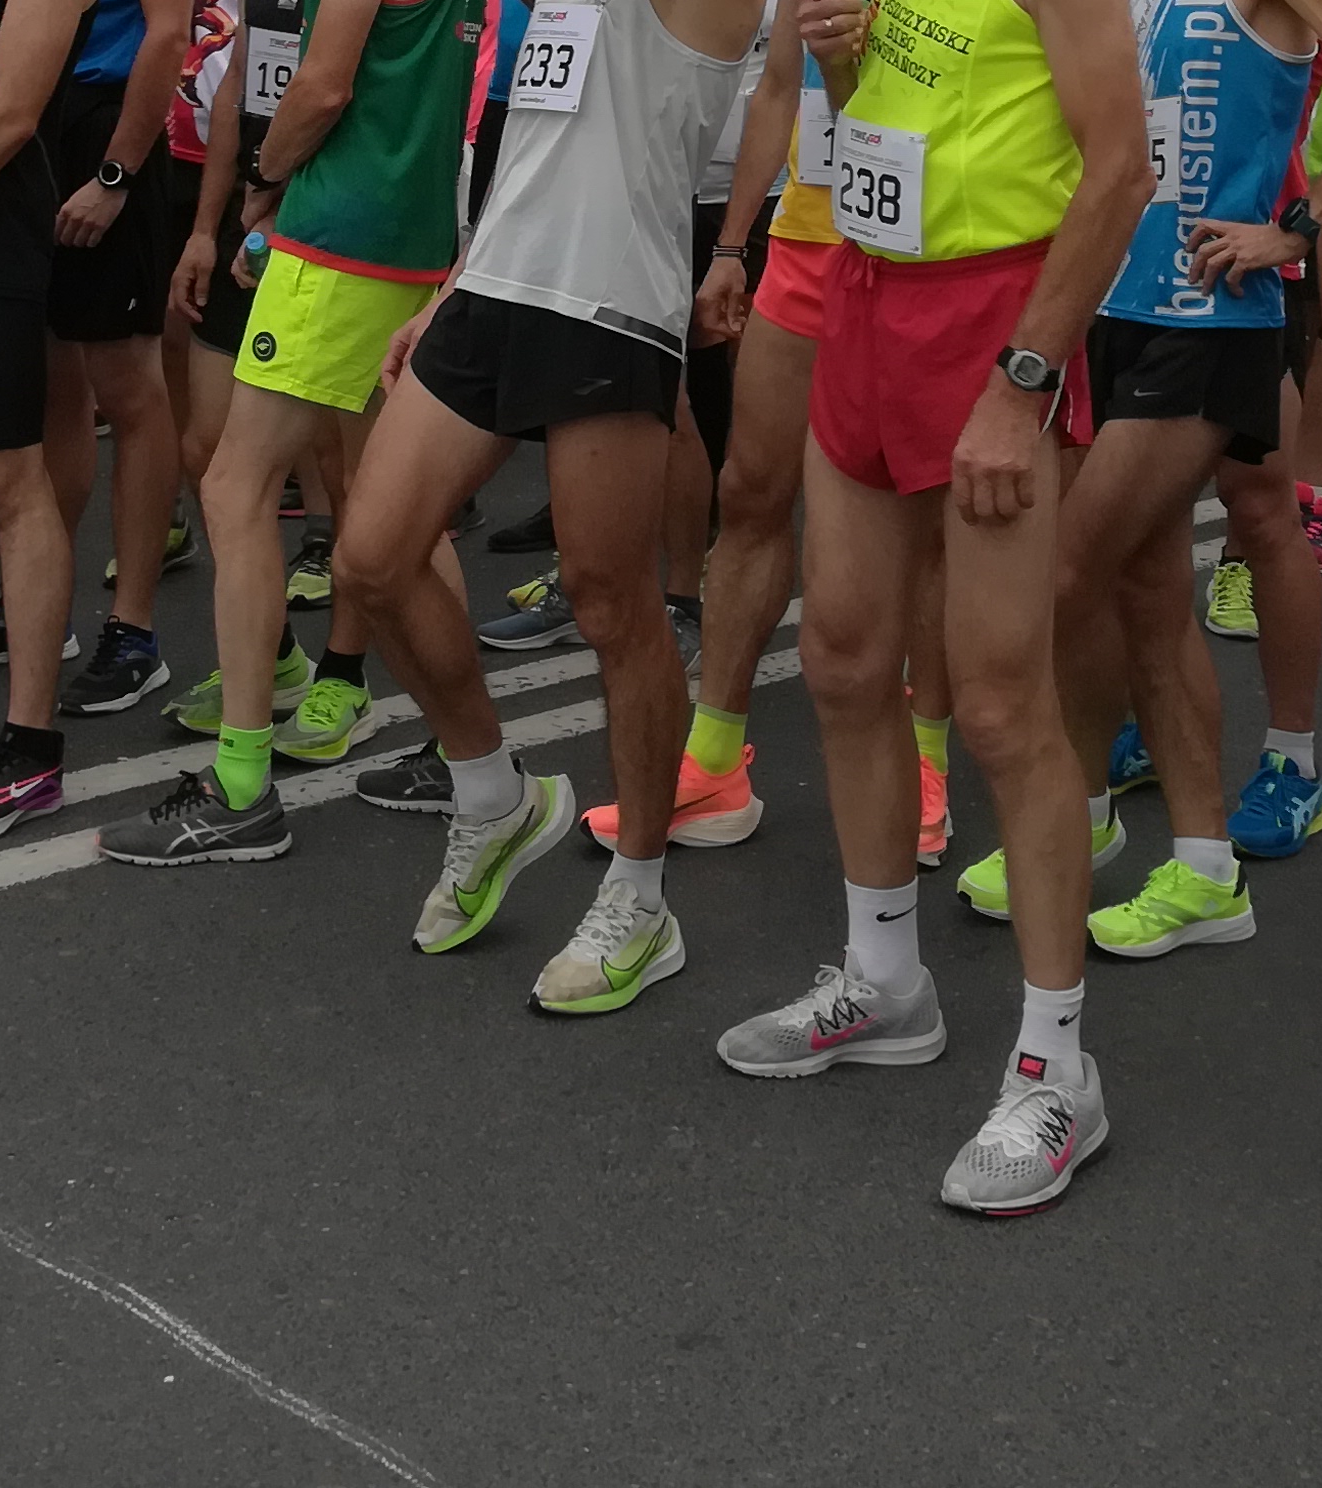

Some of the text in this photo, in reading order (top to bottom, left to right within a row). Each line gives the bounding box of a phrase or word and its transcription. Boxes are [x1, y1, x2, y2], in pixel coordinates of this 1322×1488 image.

[885, 21, 917, 54] BIEG
[256, 62, 293, 100] 19
[517, 43, 575, 89] 233
[840, 162, 901, 225] 238
